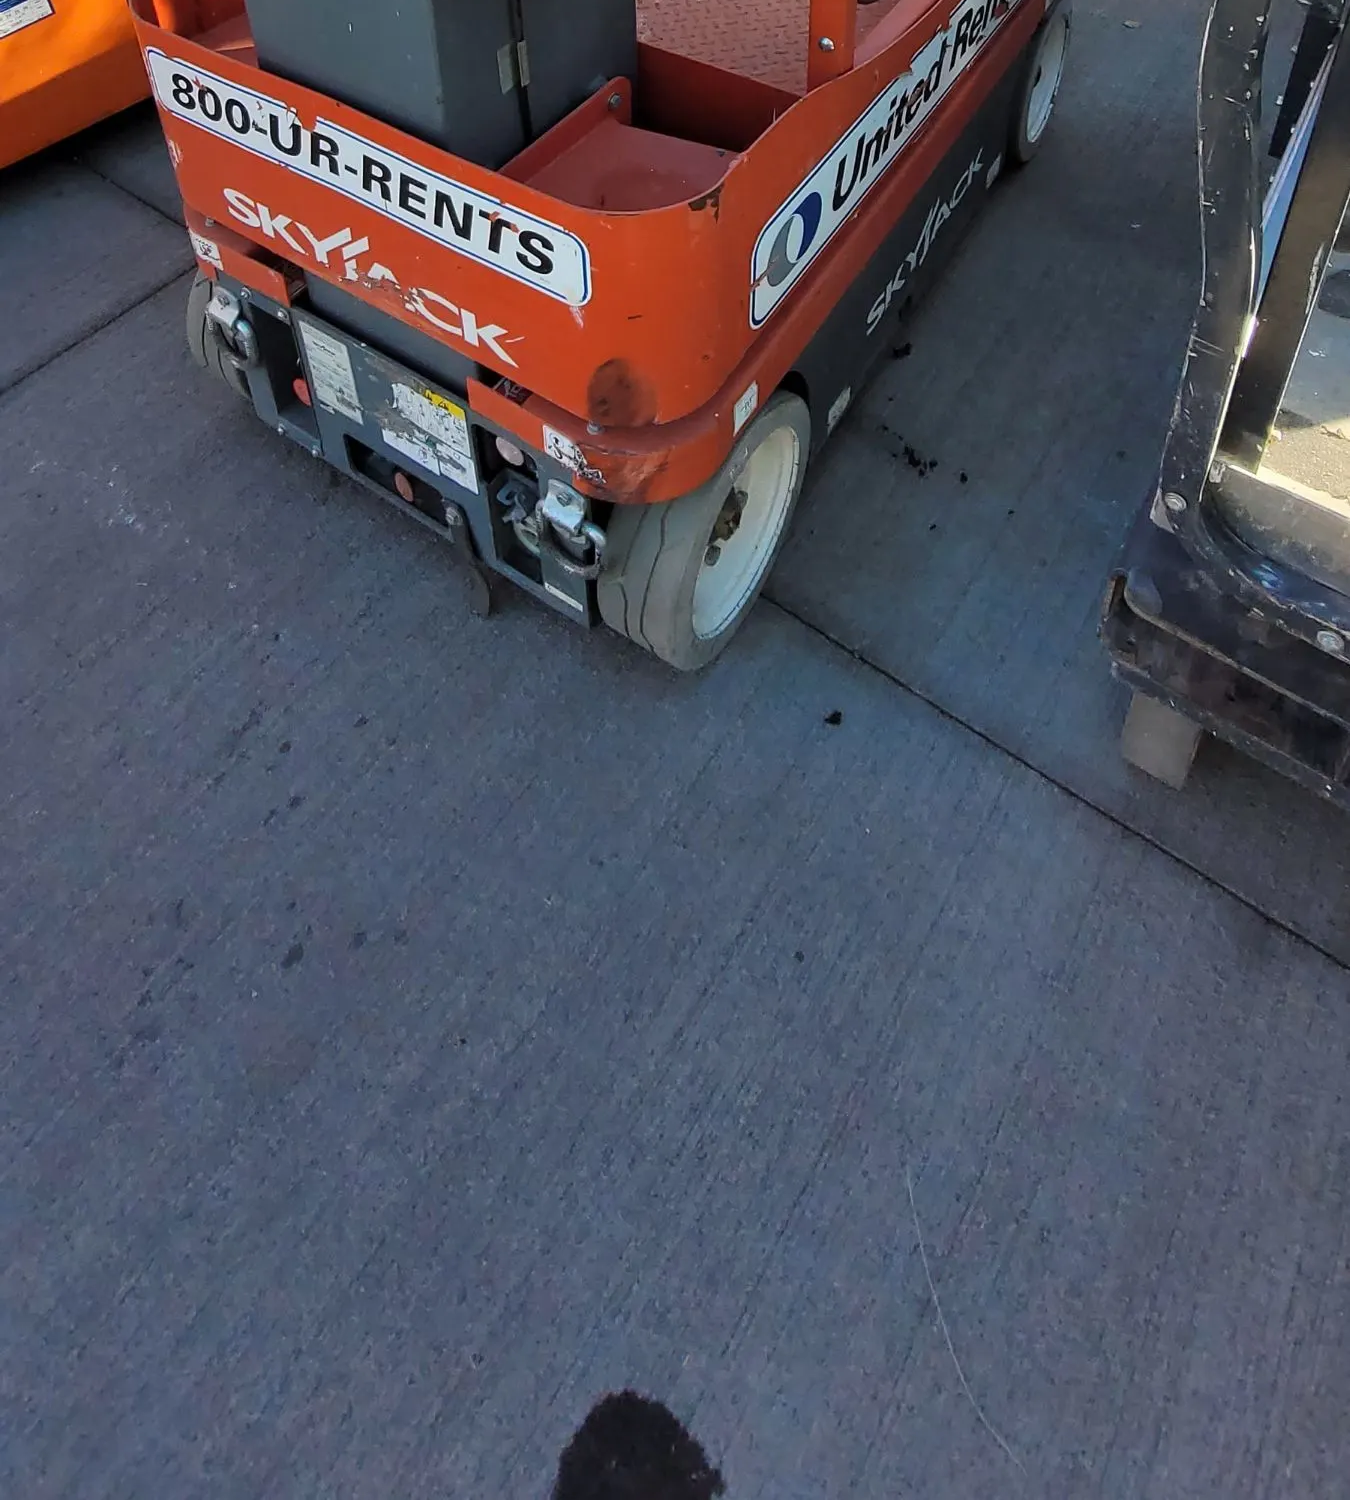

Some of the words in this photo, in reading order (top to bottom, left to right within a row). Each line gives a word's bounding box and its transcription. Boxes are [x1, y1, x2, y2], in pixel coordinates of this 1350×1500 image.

[171, 73, 556, 276] 800-UR-RENTS
[831, 37, 950, 213] United
[866, 146, 985, 336] SKYJACK
